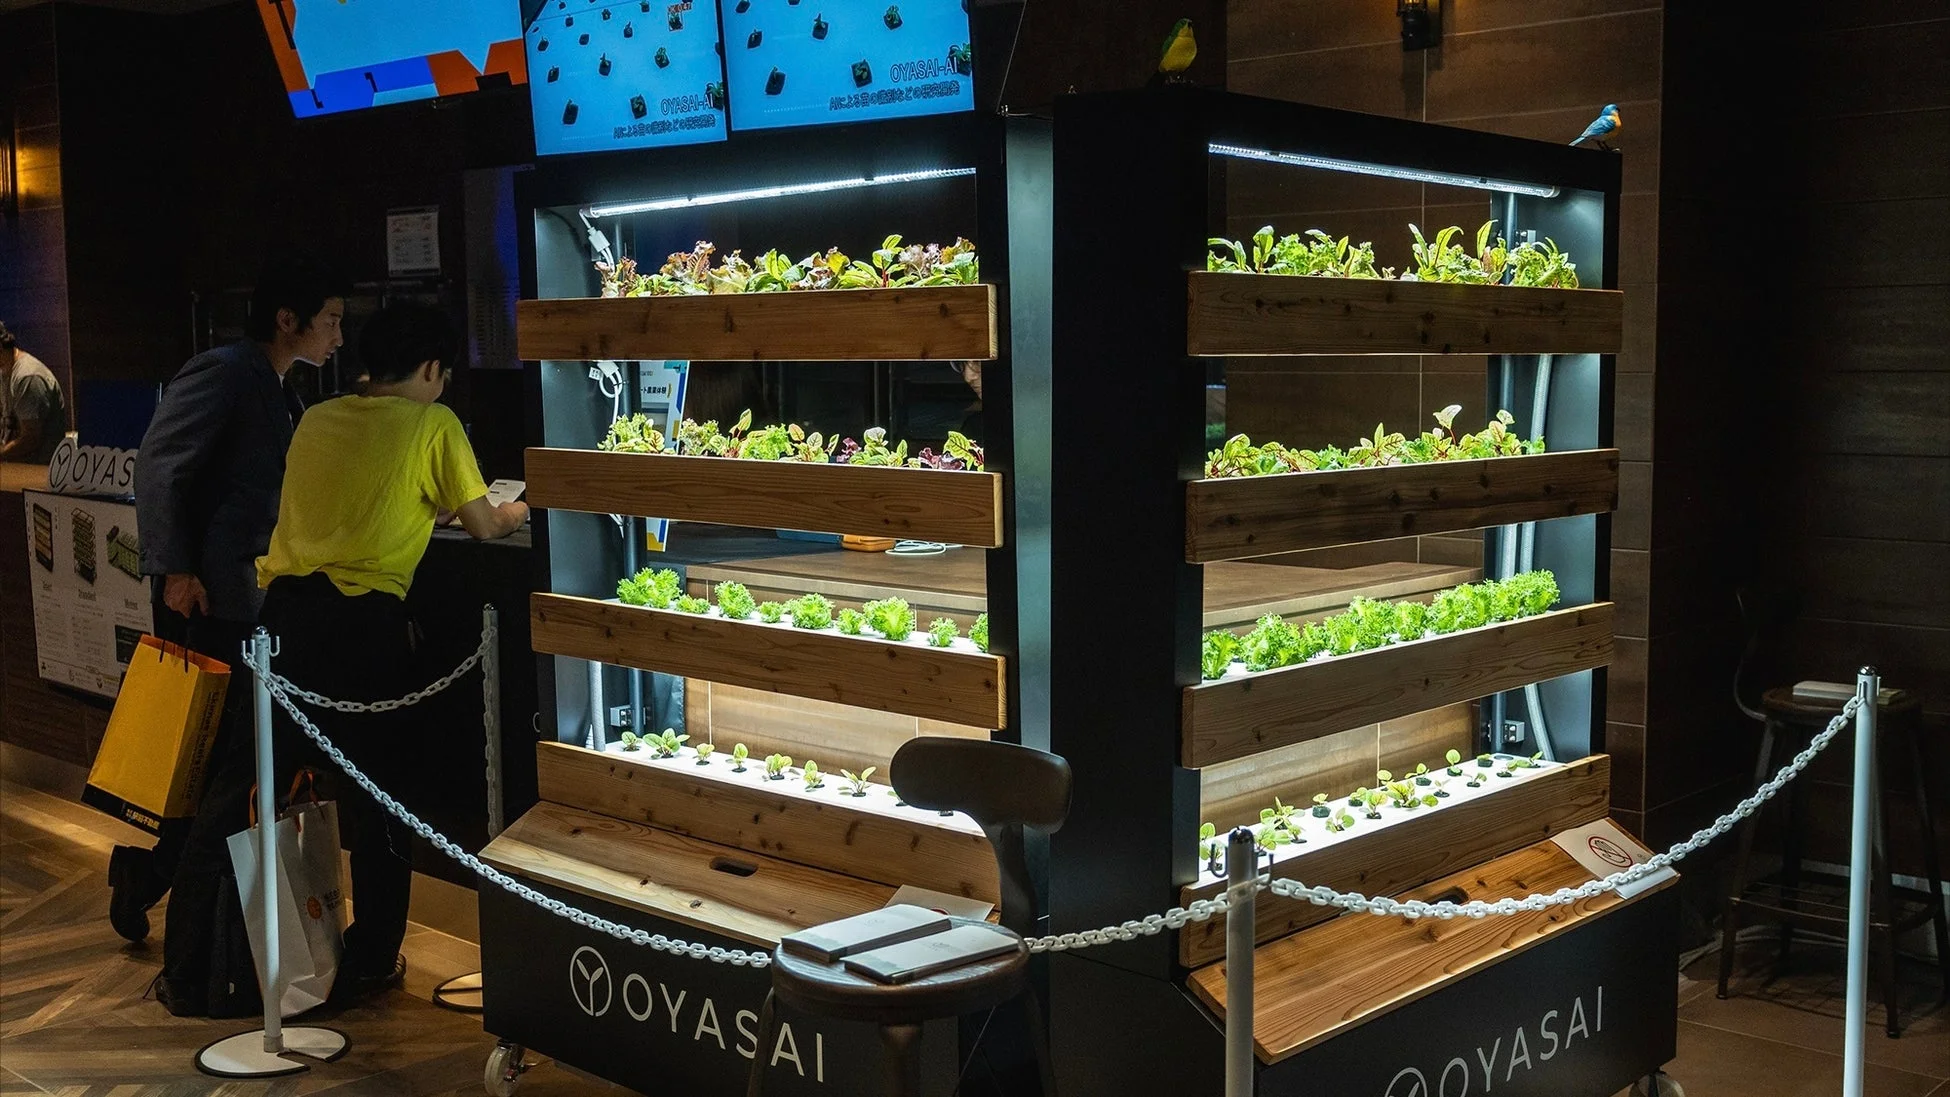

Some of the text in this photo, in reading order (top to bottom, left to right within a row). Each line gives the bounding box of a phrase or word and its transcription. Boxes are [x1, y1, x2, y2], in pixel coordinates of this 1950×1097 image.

[890, 57, 958, 82] OYASAI-AI
[661, 93, 714, 116] OYASAI-AI
[622, 972, 825, 1083] OYASAI
[1439, 986, 1603, 1097] OYASAI
